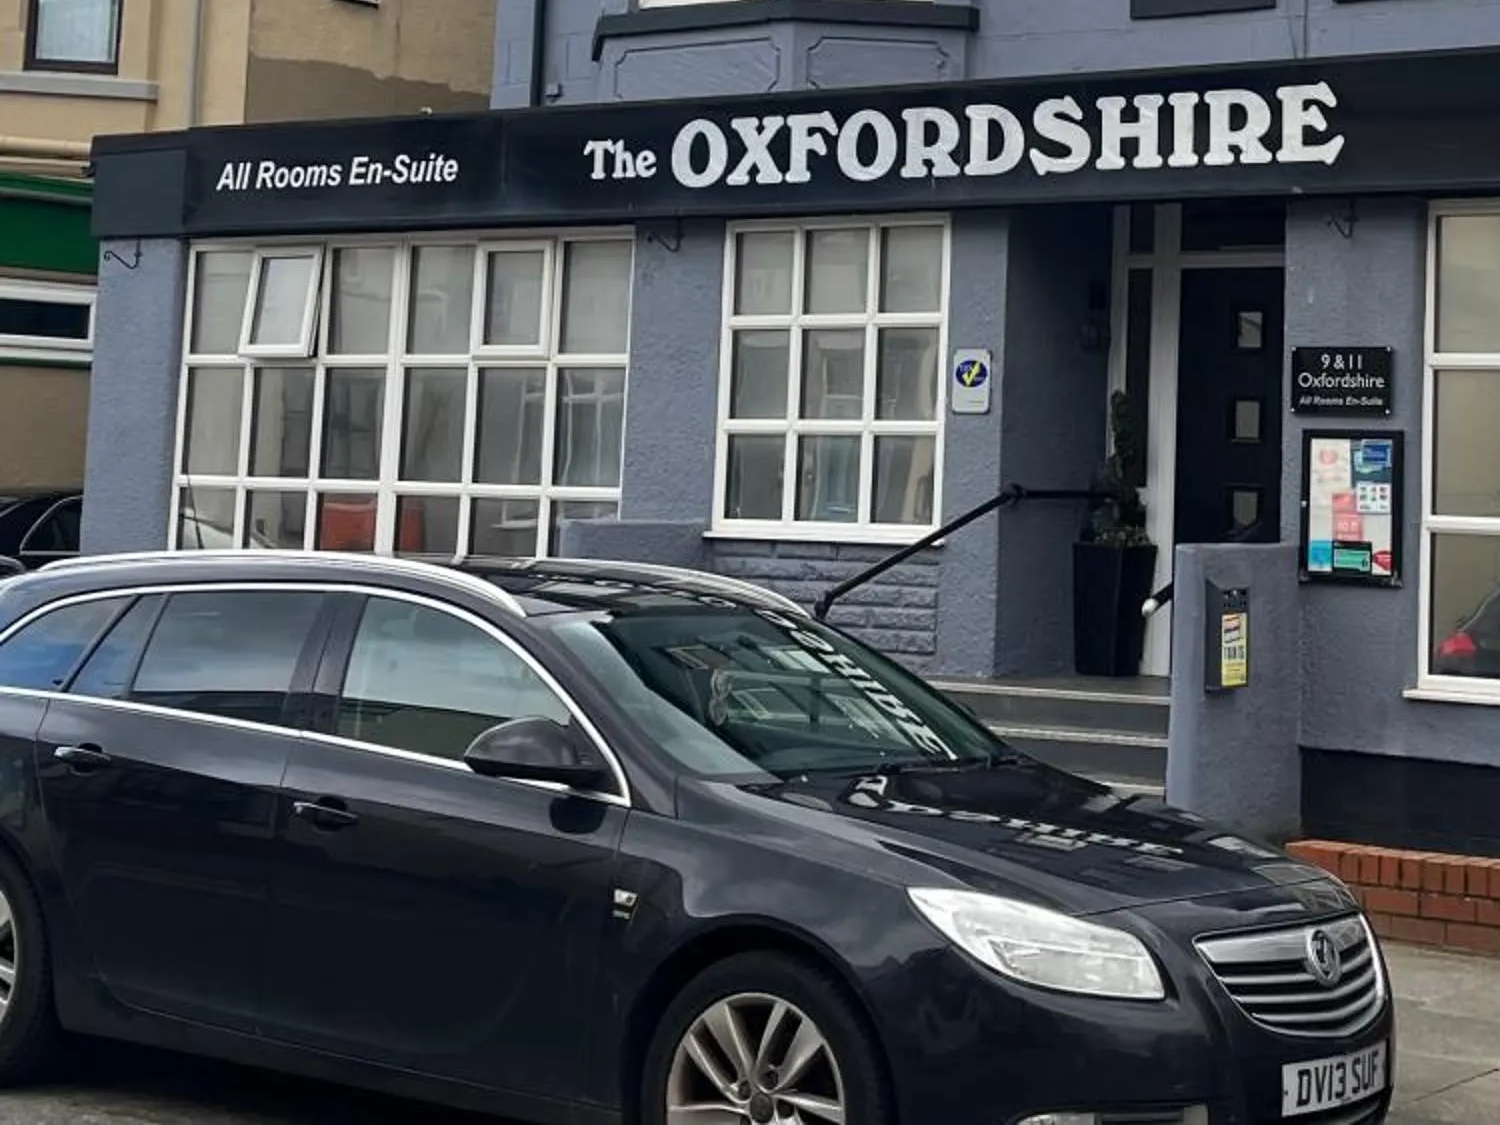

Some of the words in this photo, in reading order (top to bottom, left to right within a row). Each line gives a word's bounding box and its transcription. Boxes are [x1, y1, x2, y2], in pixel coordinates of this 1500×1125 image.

[583, 138, 656, 179] The
[671, 82, 1345, 187] OXFORDSHIRE
[216, 161, 252, 190] All
[255, 161, 342, 189] Rooms
[348, 152, 459, 186] En-Suite
[1297, 372, 1385, 388] Oxfordshire
[1321, 354, 1331, 369] 9
[1333, 354, 1345, 370] &
[1296, 1062, 1347, 1107] DV13
[1352, 1050, 1379, 1094] SUF
